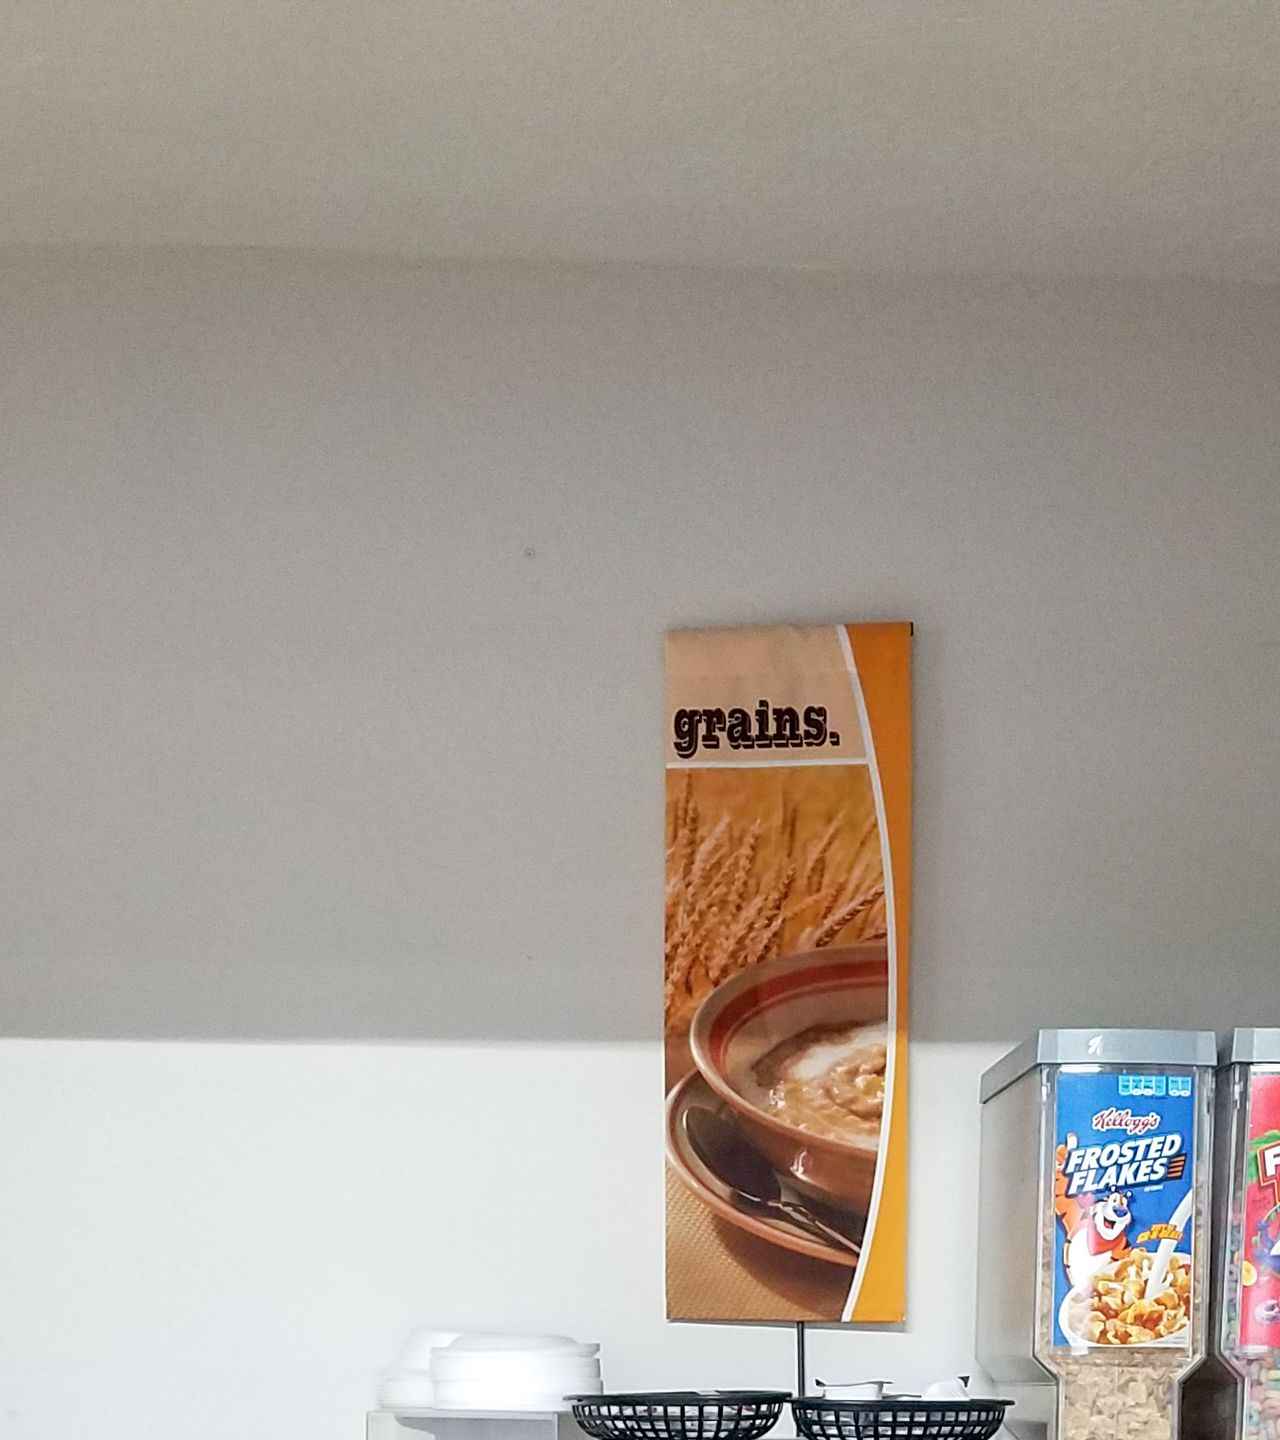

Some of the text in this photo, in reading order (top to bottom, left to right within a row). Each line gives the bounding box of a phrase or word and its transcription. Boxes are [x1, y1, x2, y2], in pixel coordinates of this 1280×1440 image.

[673, 699, 841, 759] grains.
[1093, 1108, 1160, 1134] Kellogg's
[1065, 1133, 1183, 1174] FROSTED
[1067, 1157, 1169, 1196] FLAKES
